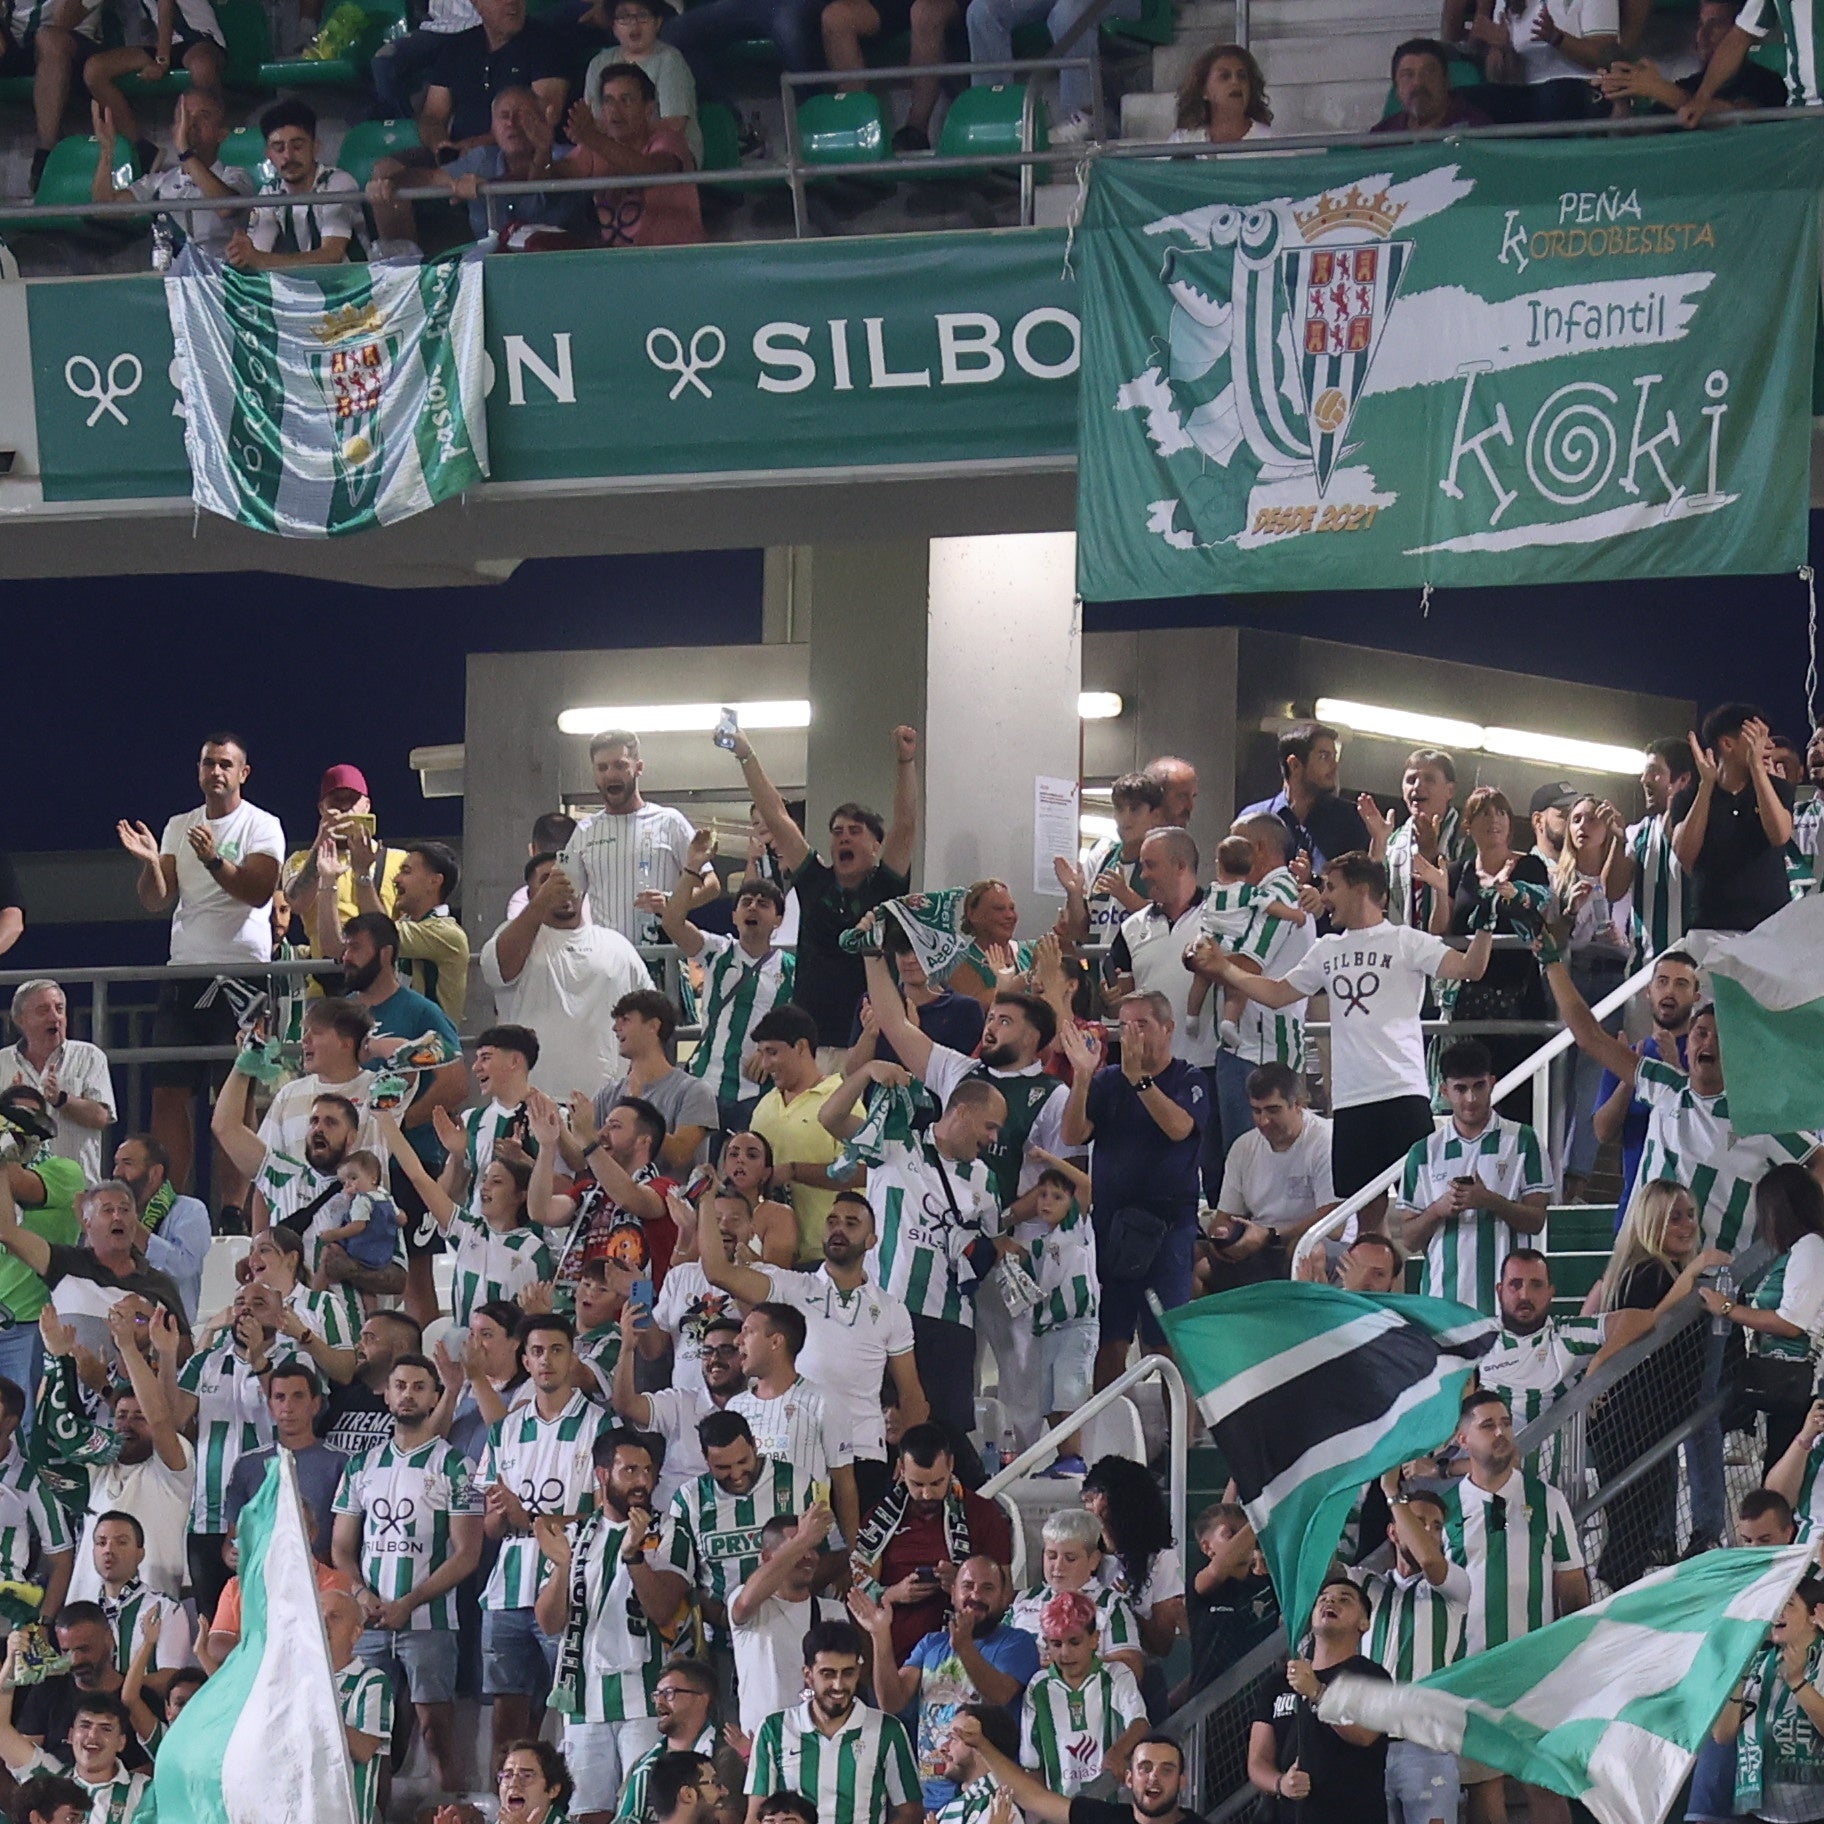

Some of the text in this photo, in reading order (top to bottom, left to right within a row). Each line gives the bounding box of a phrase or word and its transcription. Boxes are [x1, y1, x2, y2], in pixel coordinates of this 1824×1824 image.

[1559, 186, 1642, 225] PEÑA
[1527, 292, 1665, 347] Infantil
[752, 305, 1080, 394] SILBO
[1251, 503, 1379, 536] DESDE 2021
[1323, 952, 1392, 975] SILBON
